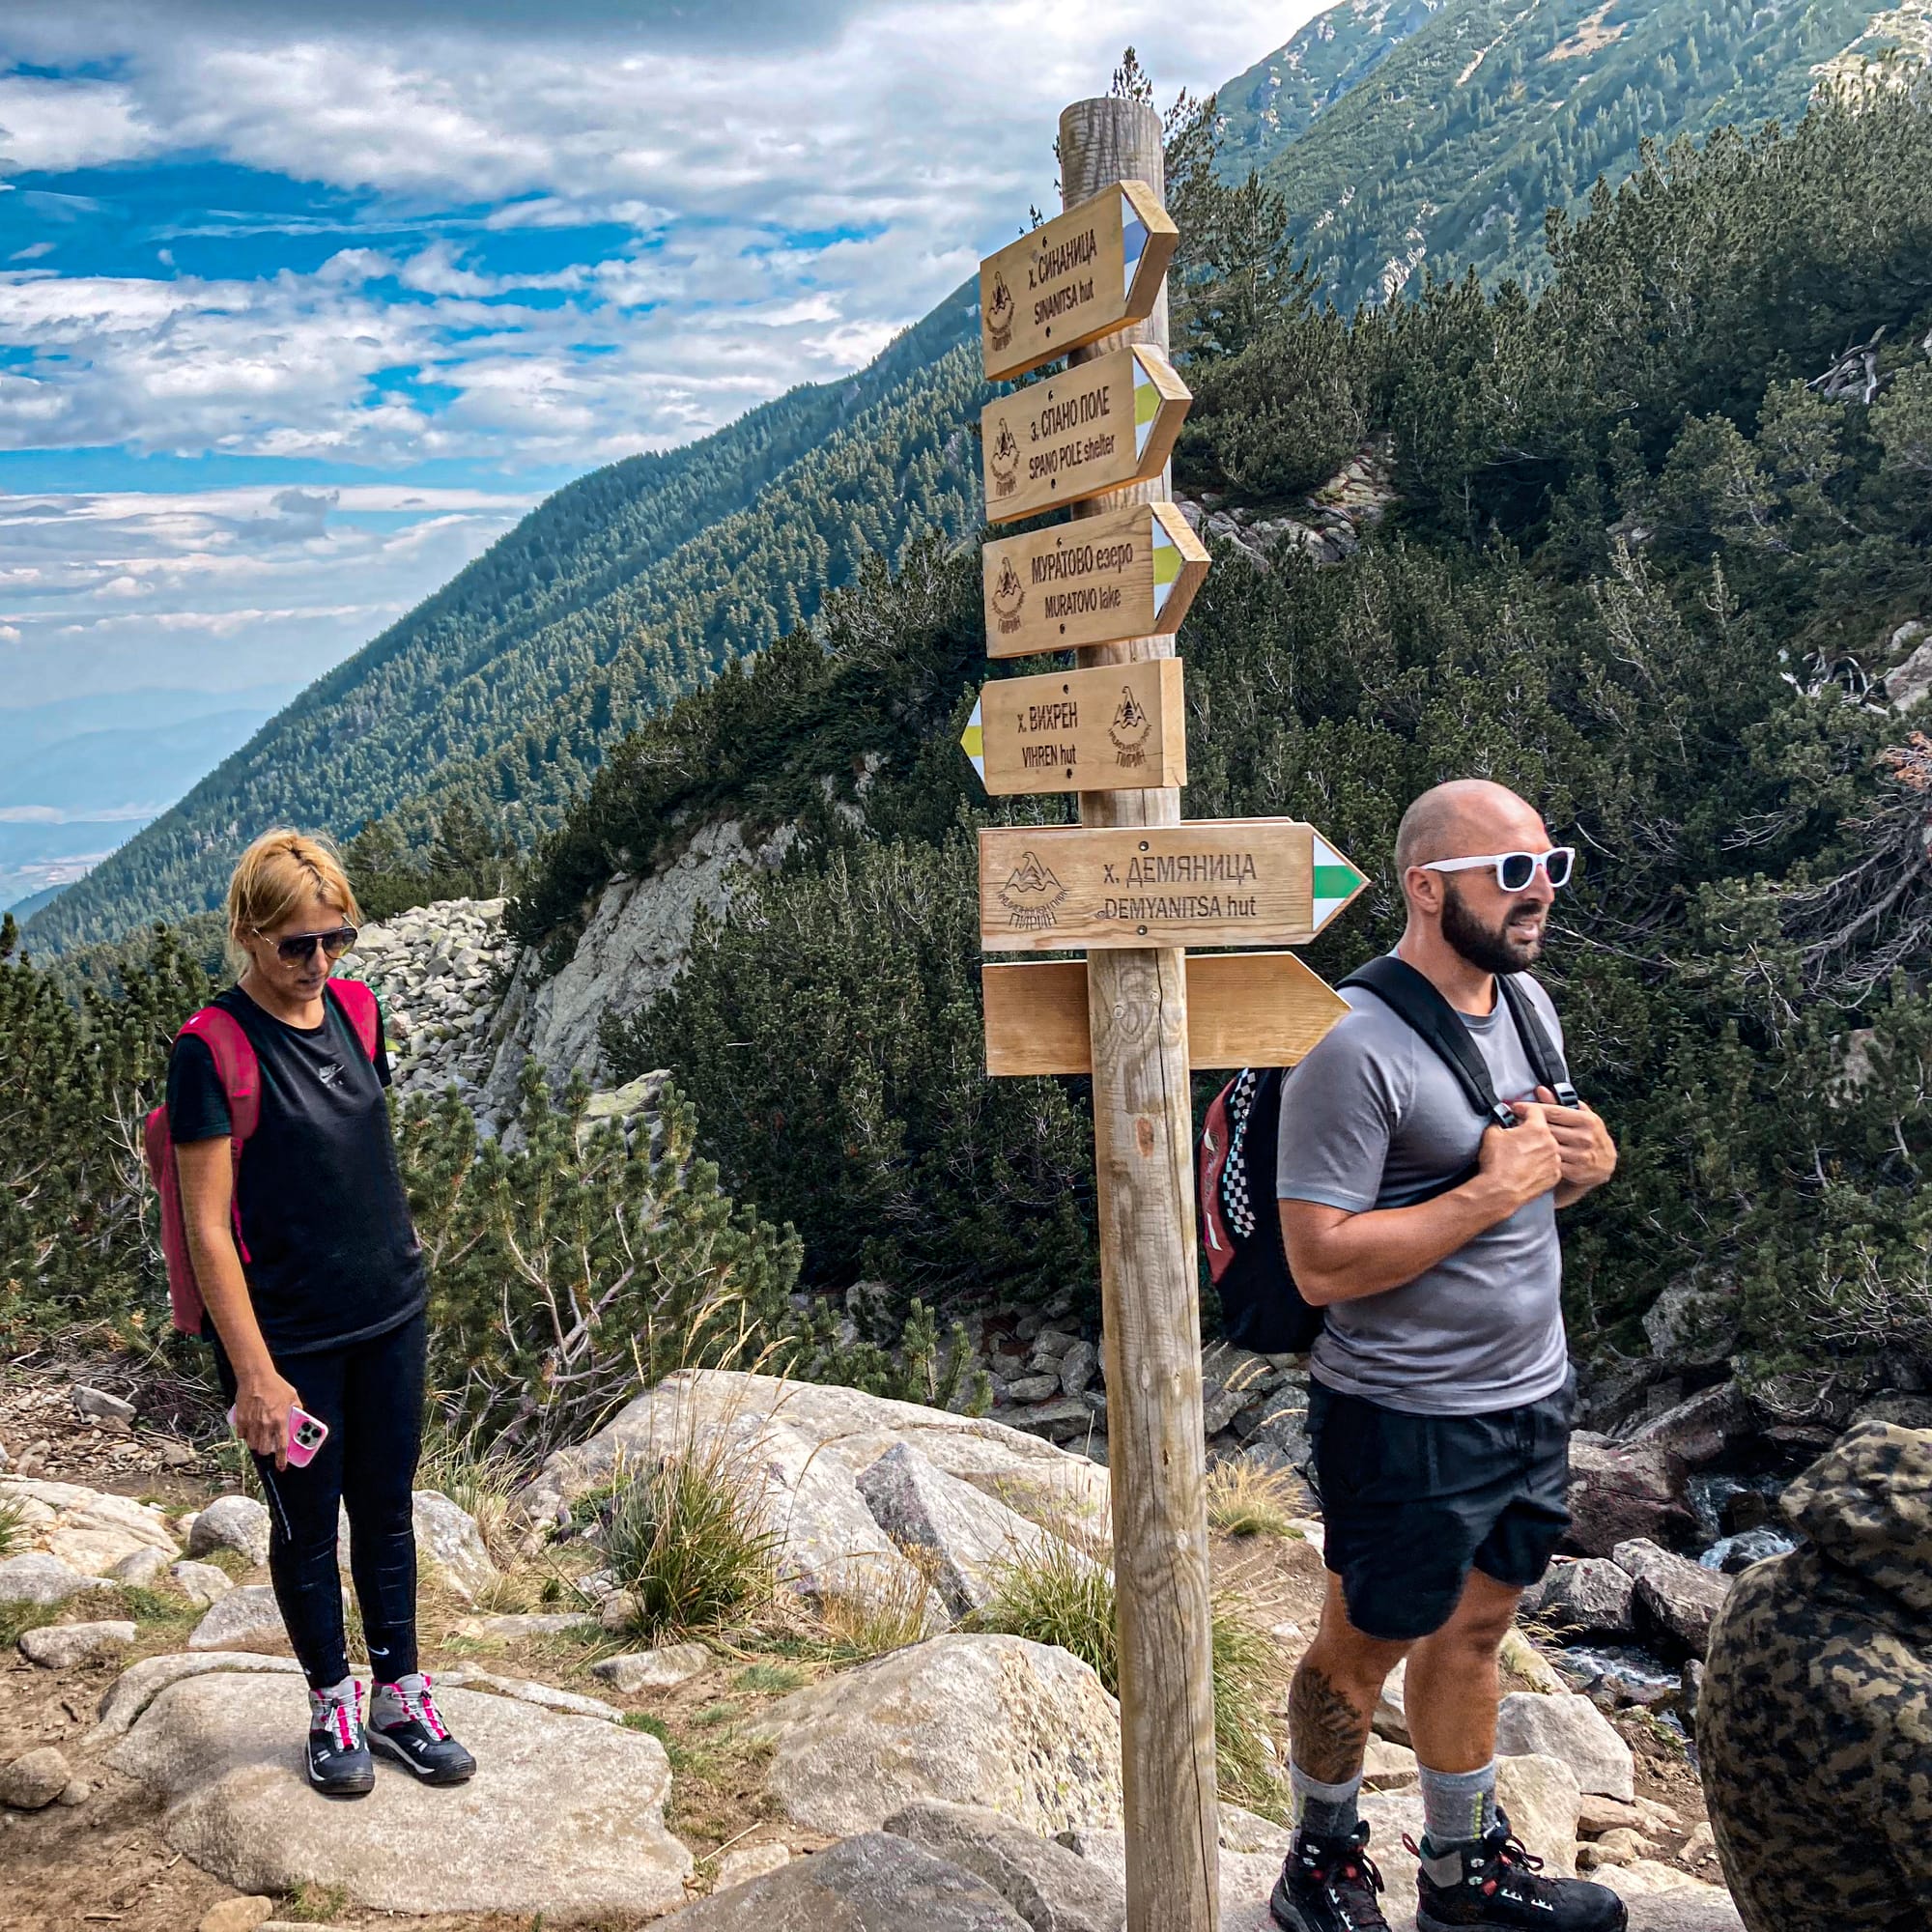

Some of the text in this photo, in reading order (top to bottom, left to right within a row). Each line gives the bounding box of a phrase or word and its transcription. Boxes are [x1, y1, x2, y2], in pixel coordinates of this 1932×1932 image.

[1038, 228, 1097, 284] СИНАНИЦА
[1035, 284, 1079, 326] SINANITSA
[1079, 276, 1094, 303] hut
[1041, 399, 1078, 438] СПАНО
[1080, 385, 1110, 423] ПОЛЕ
[1029, 449, 1059, 480] SPANO
[1059, 440, 1083, 470] POLE
[1083, 433, 1115, 462] shelter
[1032, 543, 1133, 584] МУРАТОВО езеро
[1045, 587, 1097, 619] MURATOVO
[1098, 584, 1122, 610] lake
[1029, 701, 1078, 732] ВИХРЕН
[1022, 743, 1077, 768] VIHREN hut
[1126, 854, 1258, 889] ДЕМЯНИЦА
[1105, 895, 1258, 920] DEMYANITSA hut
